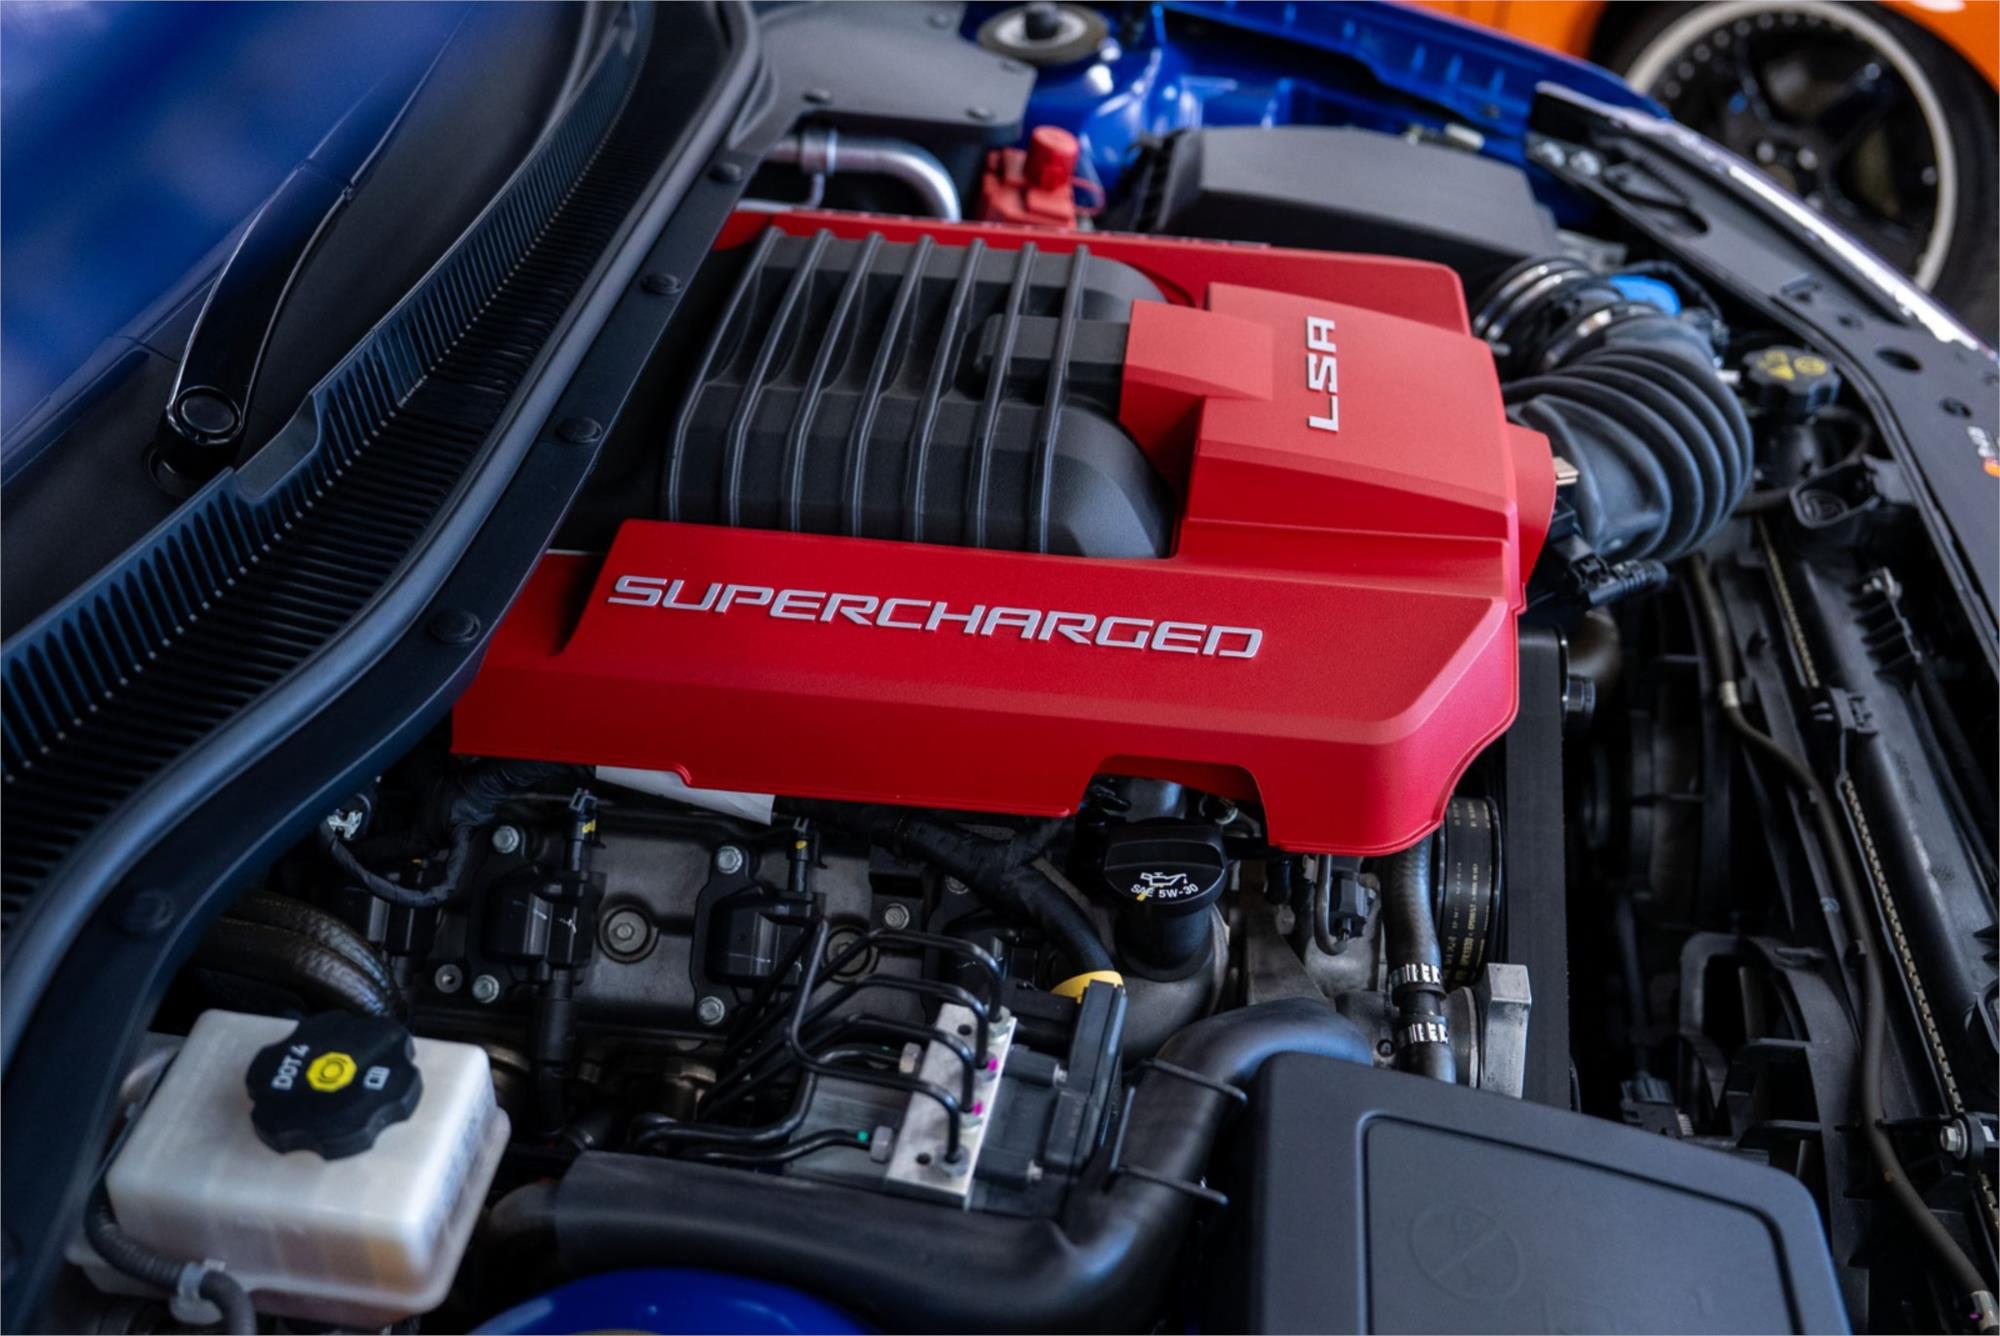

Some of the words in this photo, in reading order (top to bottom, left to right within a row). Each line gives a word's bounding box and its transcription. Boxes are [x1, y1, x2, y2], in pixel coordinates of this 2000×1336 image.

[1306, 315, 1339, 432] LSA
[608, 575, 1264, 659] SUPERCHARGED
[1159, 884, 1199, 899] 5W-30
[272, 1055, 303, 1091] DOT
